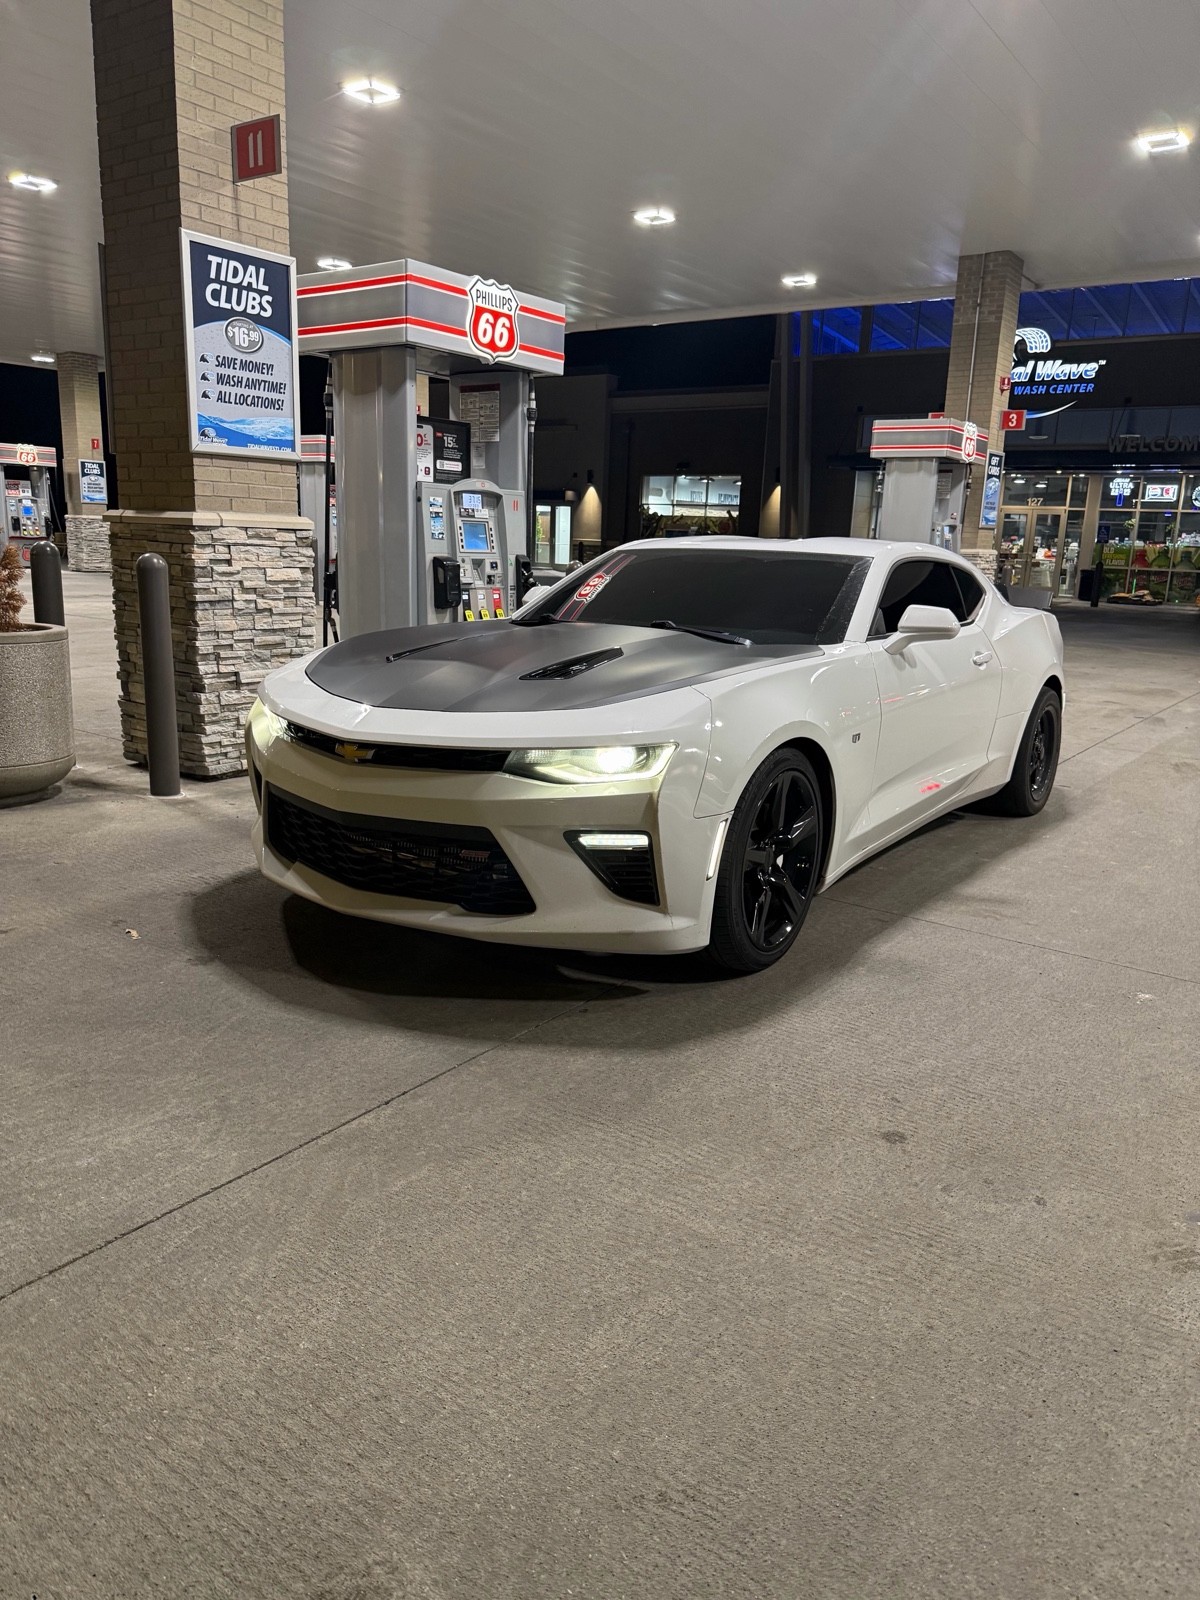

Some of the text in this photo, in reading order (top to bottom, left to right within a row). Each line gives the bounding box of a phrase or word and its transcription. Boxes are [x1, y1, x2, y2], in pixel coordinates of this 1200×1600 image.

[248, 129, 264, 169] 11
[207, 254, 269, 291] TIDAL
[205, 282, 273, 318] CLUBS
[475, 289, 513, 312] PHILLIPS
[227, 326, 259, 347] $16.99
[477, 312, 511, 348] 66
[215, 355, 274, 376] SAVE MONEY!
[216, 373, 287, 395] WASH ANYTIME!
[1014, 383, 1095, 395] WASH CENTER
[216, 390, 285, 411] ALL LOCATIONS!
[1008, 413, 1017, 427] 3
[93, 440, 98, 448] 7
[965, 438, 975, 456] 66
[21, 453, 34, 462] 66
[991, 456, 1000, 466] GIFT
[988, 465, 1001, 476] CARDS
[1027, 497, 1044, 506] 127
